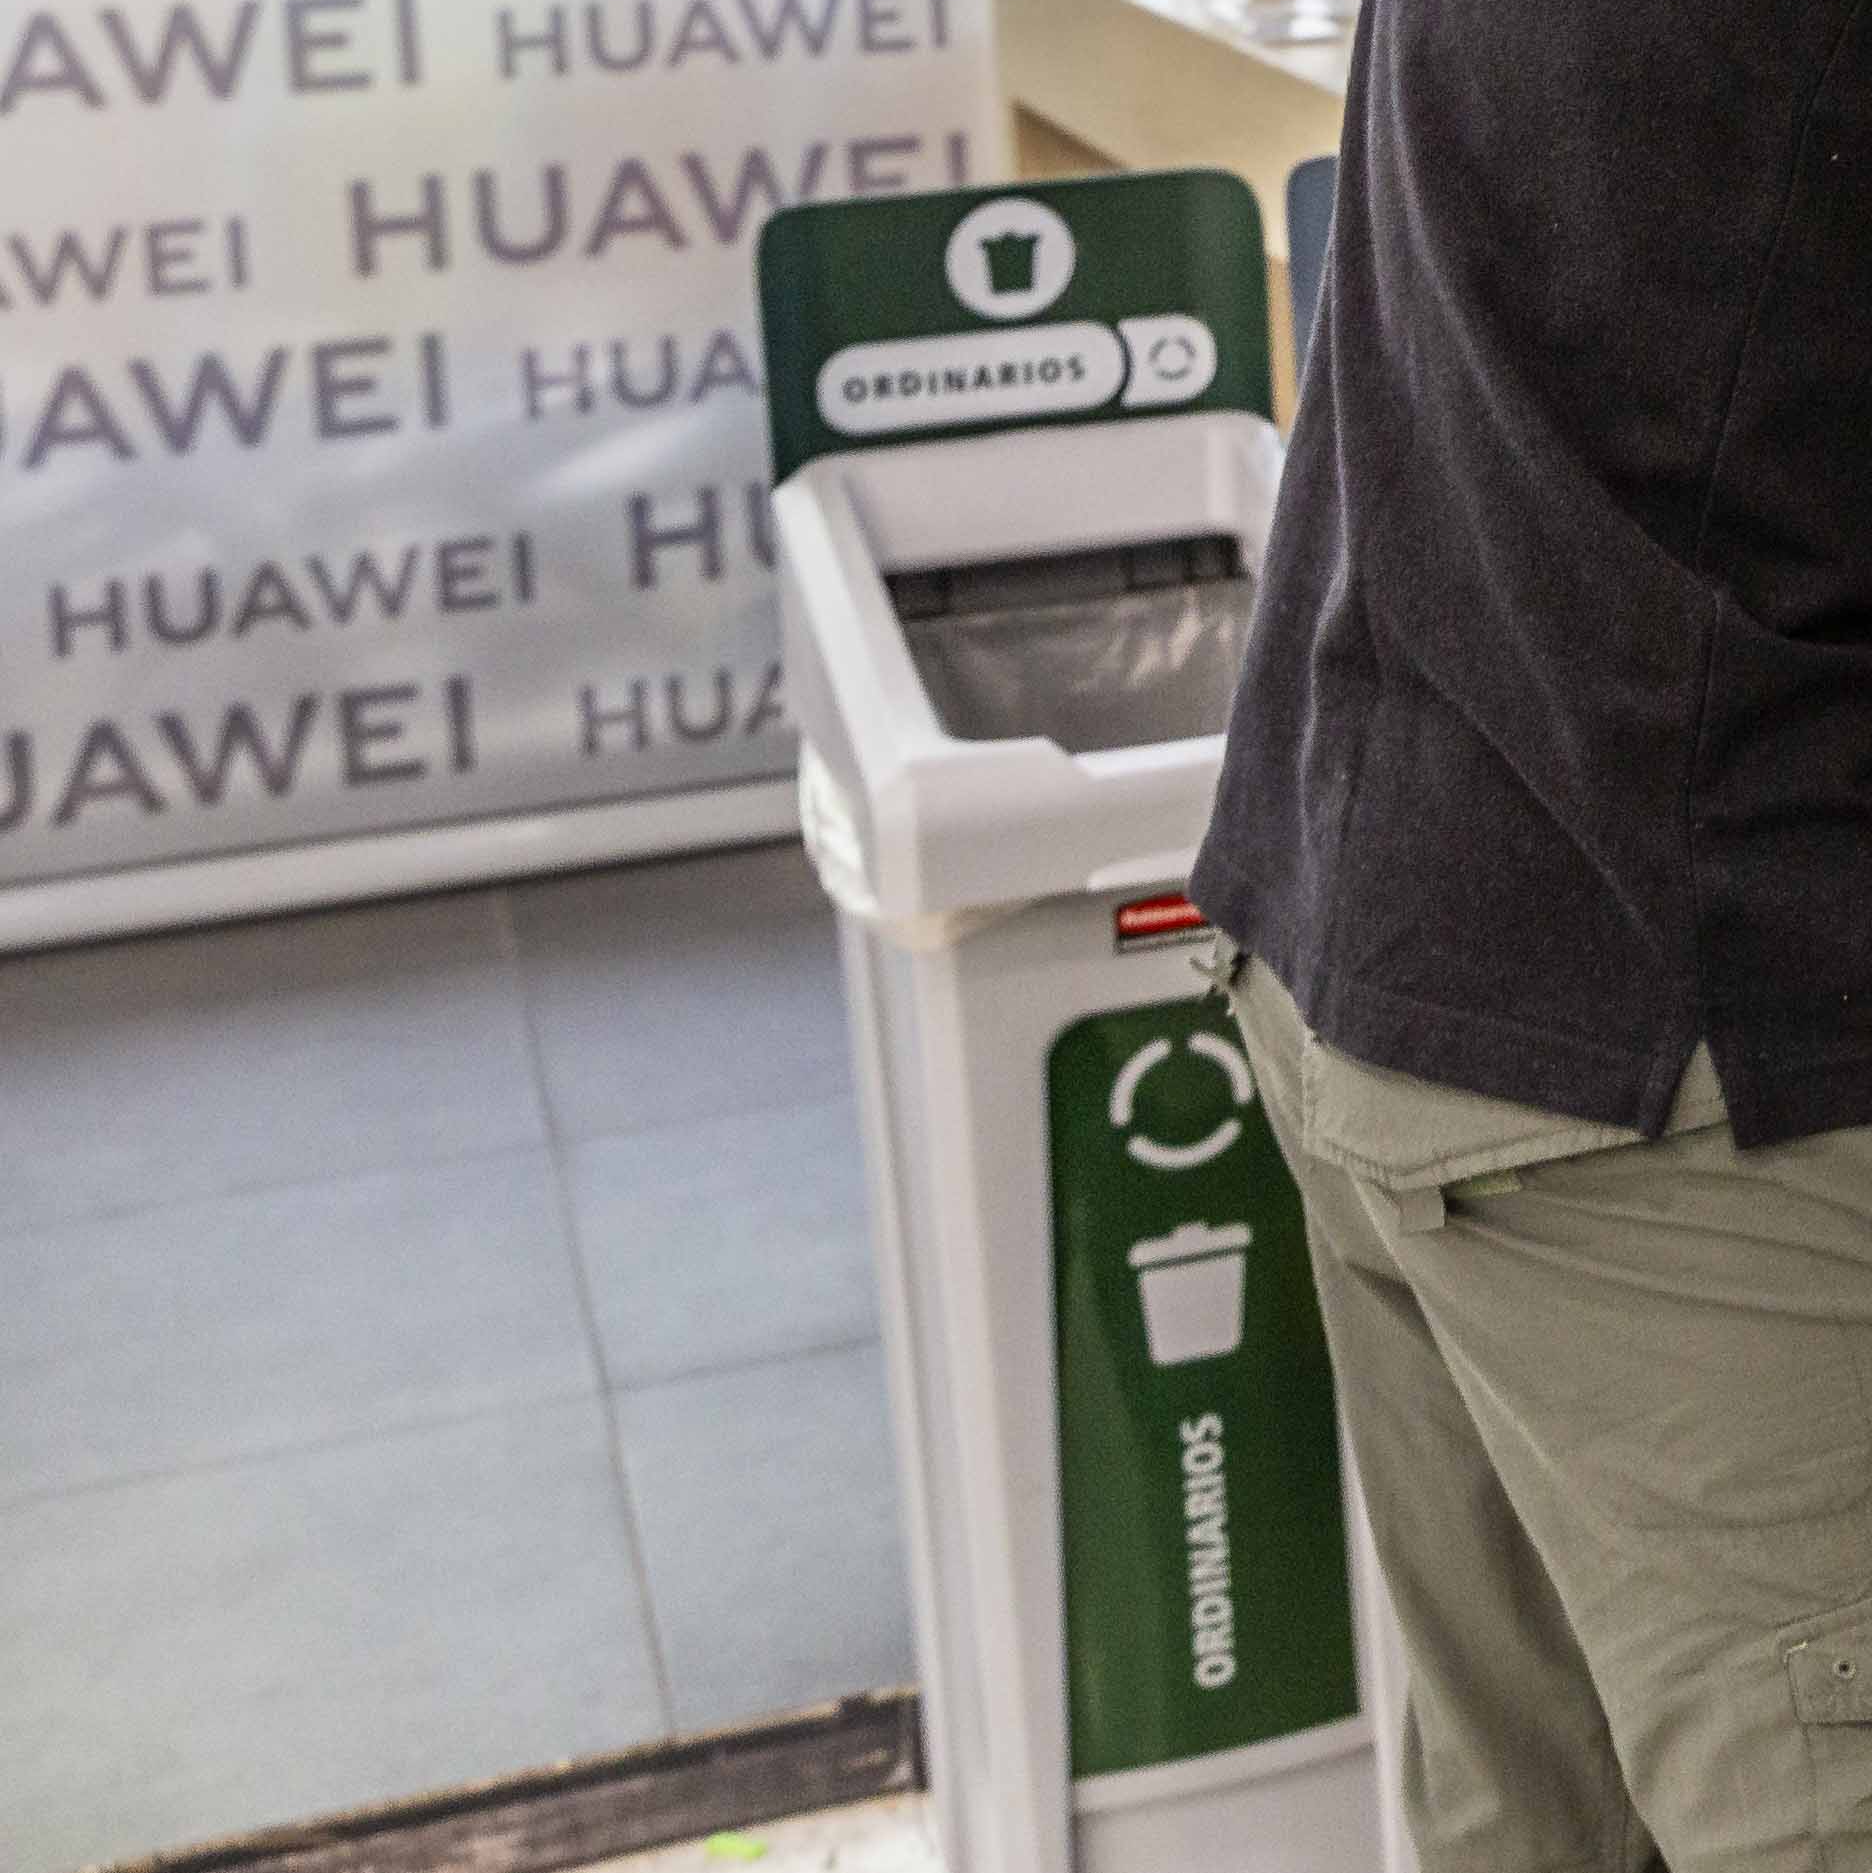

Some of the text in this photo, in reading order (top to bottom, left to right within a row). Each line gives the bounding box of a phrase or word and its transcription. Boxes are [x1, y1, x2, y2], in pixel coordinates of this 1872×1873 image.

[0, 216, 251, 312] WEI
[0, 332, 448, 471] AWEI
[840, 352, 1088, 406] ORDINARIOS
[47, 530, 537, 659] HUAWEI
[1178, 1411, 1237, 1690] ORDINARIOS
